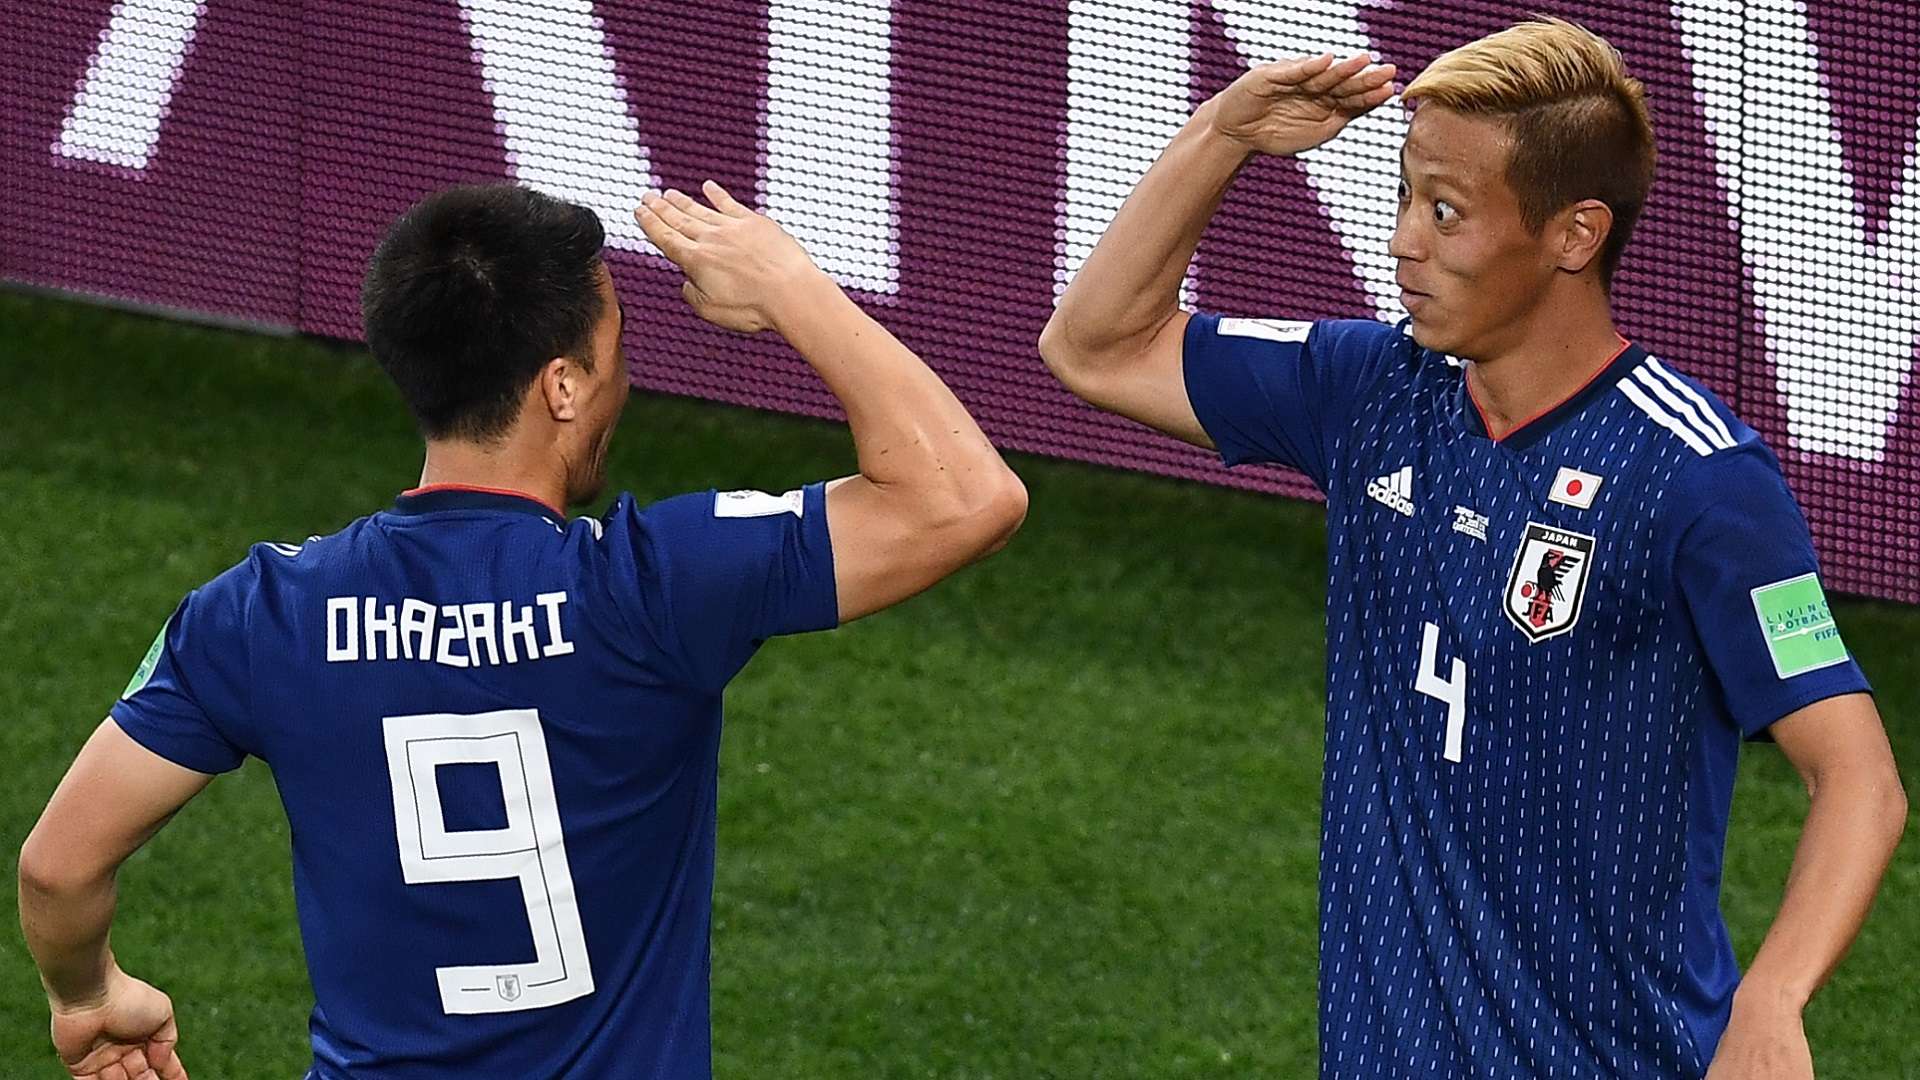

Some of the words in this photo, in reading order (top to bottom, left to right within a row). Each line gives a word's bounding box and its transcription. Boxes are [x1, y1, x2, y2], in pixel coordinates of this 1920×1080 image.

[1367, 482, 1414, 516] adidas
[1541, 531, 1578, 547] JAPAN
[327, 591, 575, 667] OKAZAKI
[1522, 601, 1553, 623] JFA
[1415, 621, 1466, 763] 4
[382, 708, 595, 1014] 9
